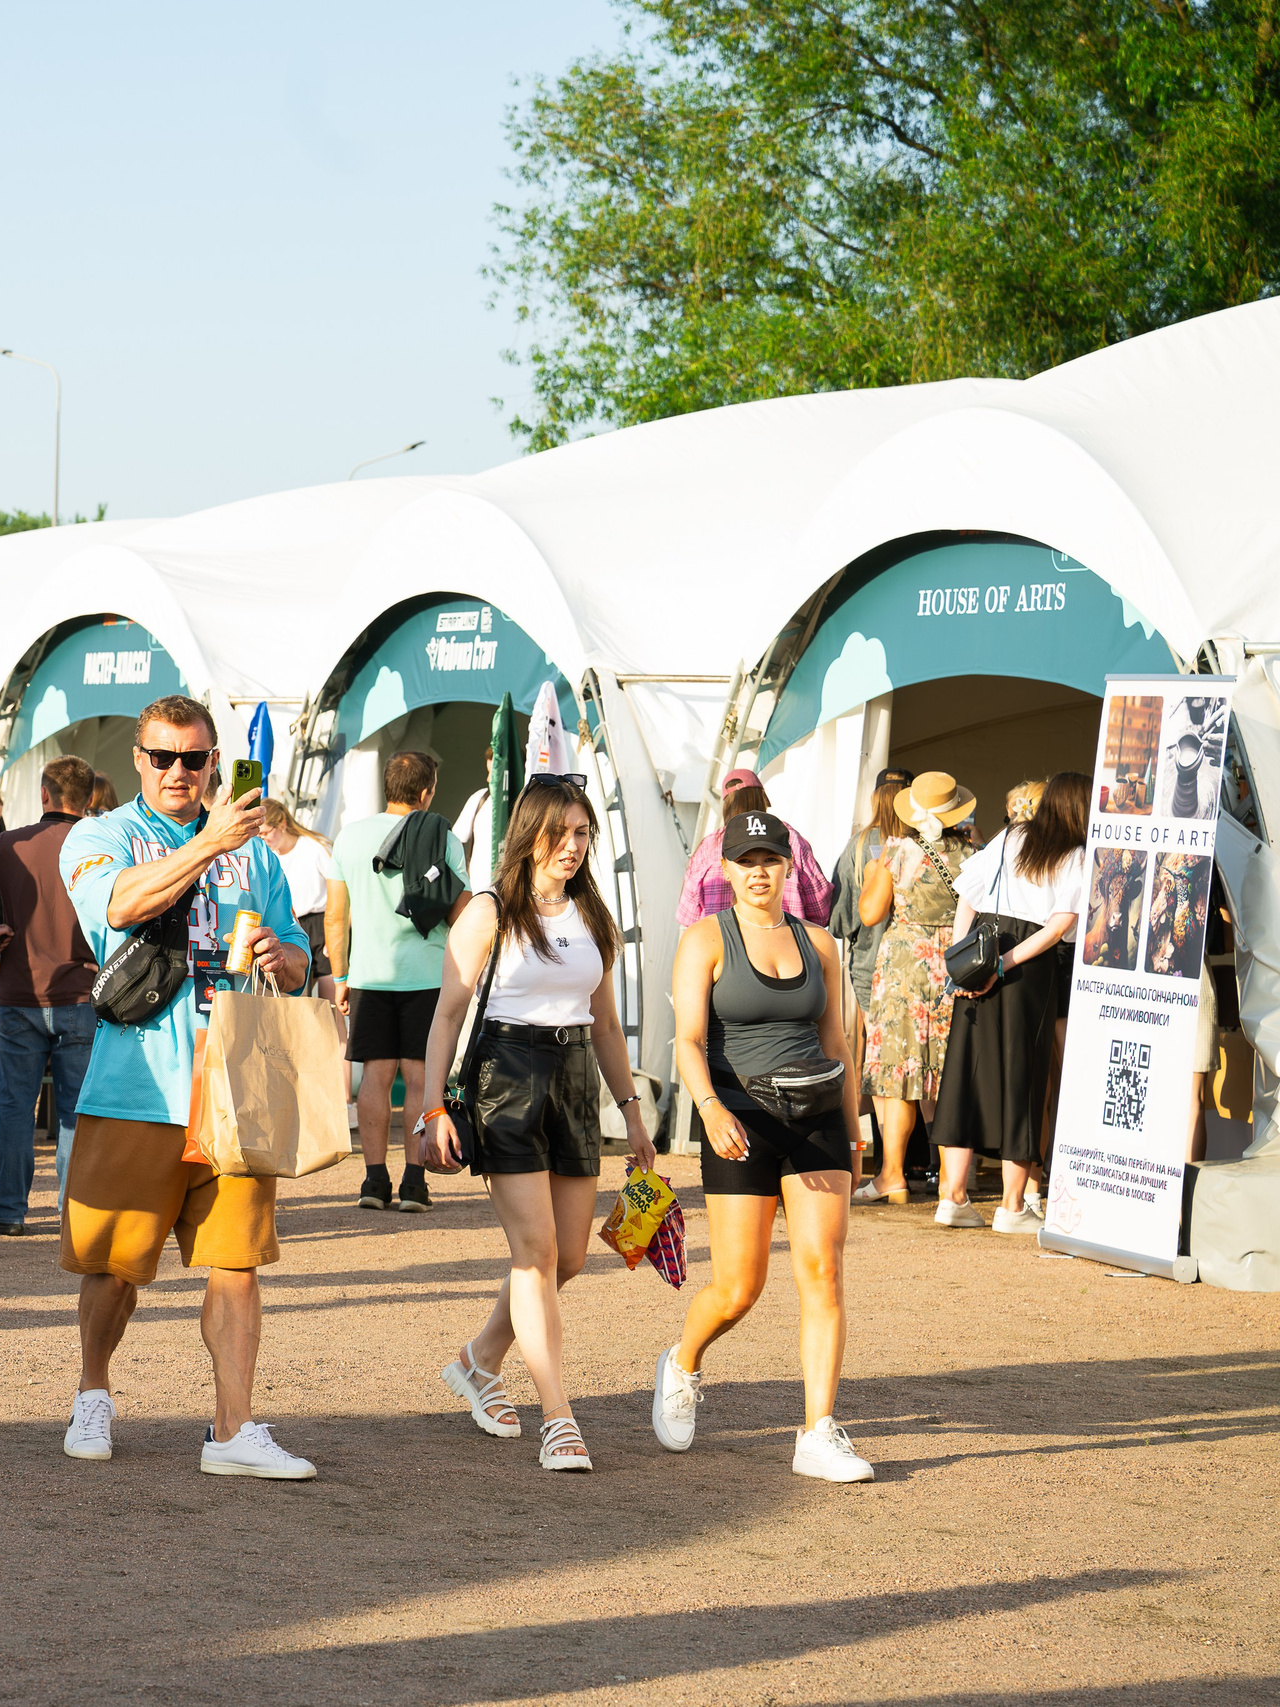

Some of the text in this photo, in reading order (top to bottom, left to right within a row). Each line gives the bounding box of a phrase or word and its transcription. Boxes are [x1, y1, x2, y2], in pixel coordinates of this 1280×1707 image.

[917, 582, 1066, 616] HOUSE OF ARTS
[746, 815, 767, 836] LA
[1091, 823, 1142, 842] HOUSE
[1150, 827, 1169, 844] OF
[1077, 979, 1135, 998] МАСТЕР-КЛАССЫ
[1136, 987, 1147, 1000] ПО
[1099, 1005, 1120, 1020] ДЕЛУ
[1126, 1009, 1170, 1026] ЖИВОПИСИ
[1059, 1143, 1106, 1162] ОТСКАНИРУЙТЕ,
[1107, 1153, 1127, 1165] ЧТОБЫ
[1128, 1157, 1155, 1172] ПЕРЕЙТИ
[1156, 1163, 1166, 1174] НА
[1069, 1159, 1085, 1172] САЙТ
[1092, 1165, 1130, 1181] ЗАПИСАТЬСЯ
[1130, 1173, 1140, 1184] НА
[1140, 1175, 1168, 1190] ЛУЧШИЕ
[622, 1183, 650, 1213] Nachos
[1076, 1176, 1125, 1196] МАСТЕР-КЛАССЫ
[1131, 1188, 1156, 1203] МОСКВЕ
